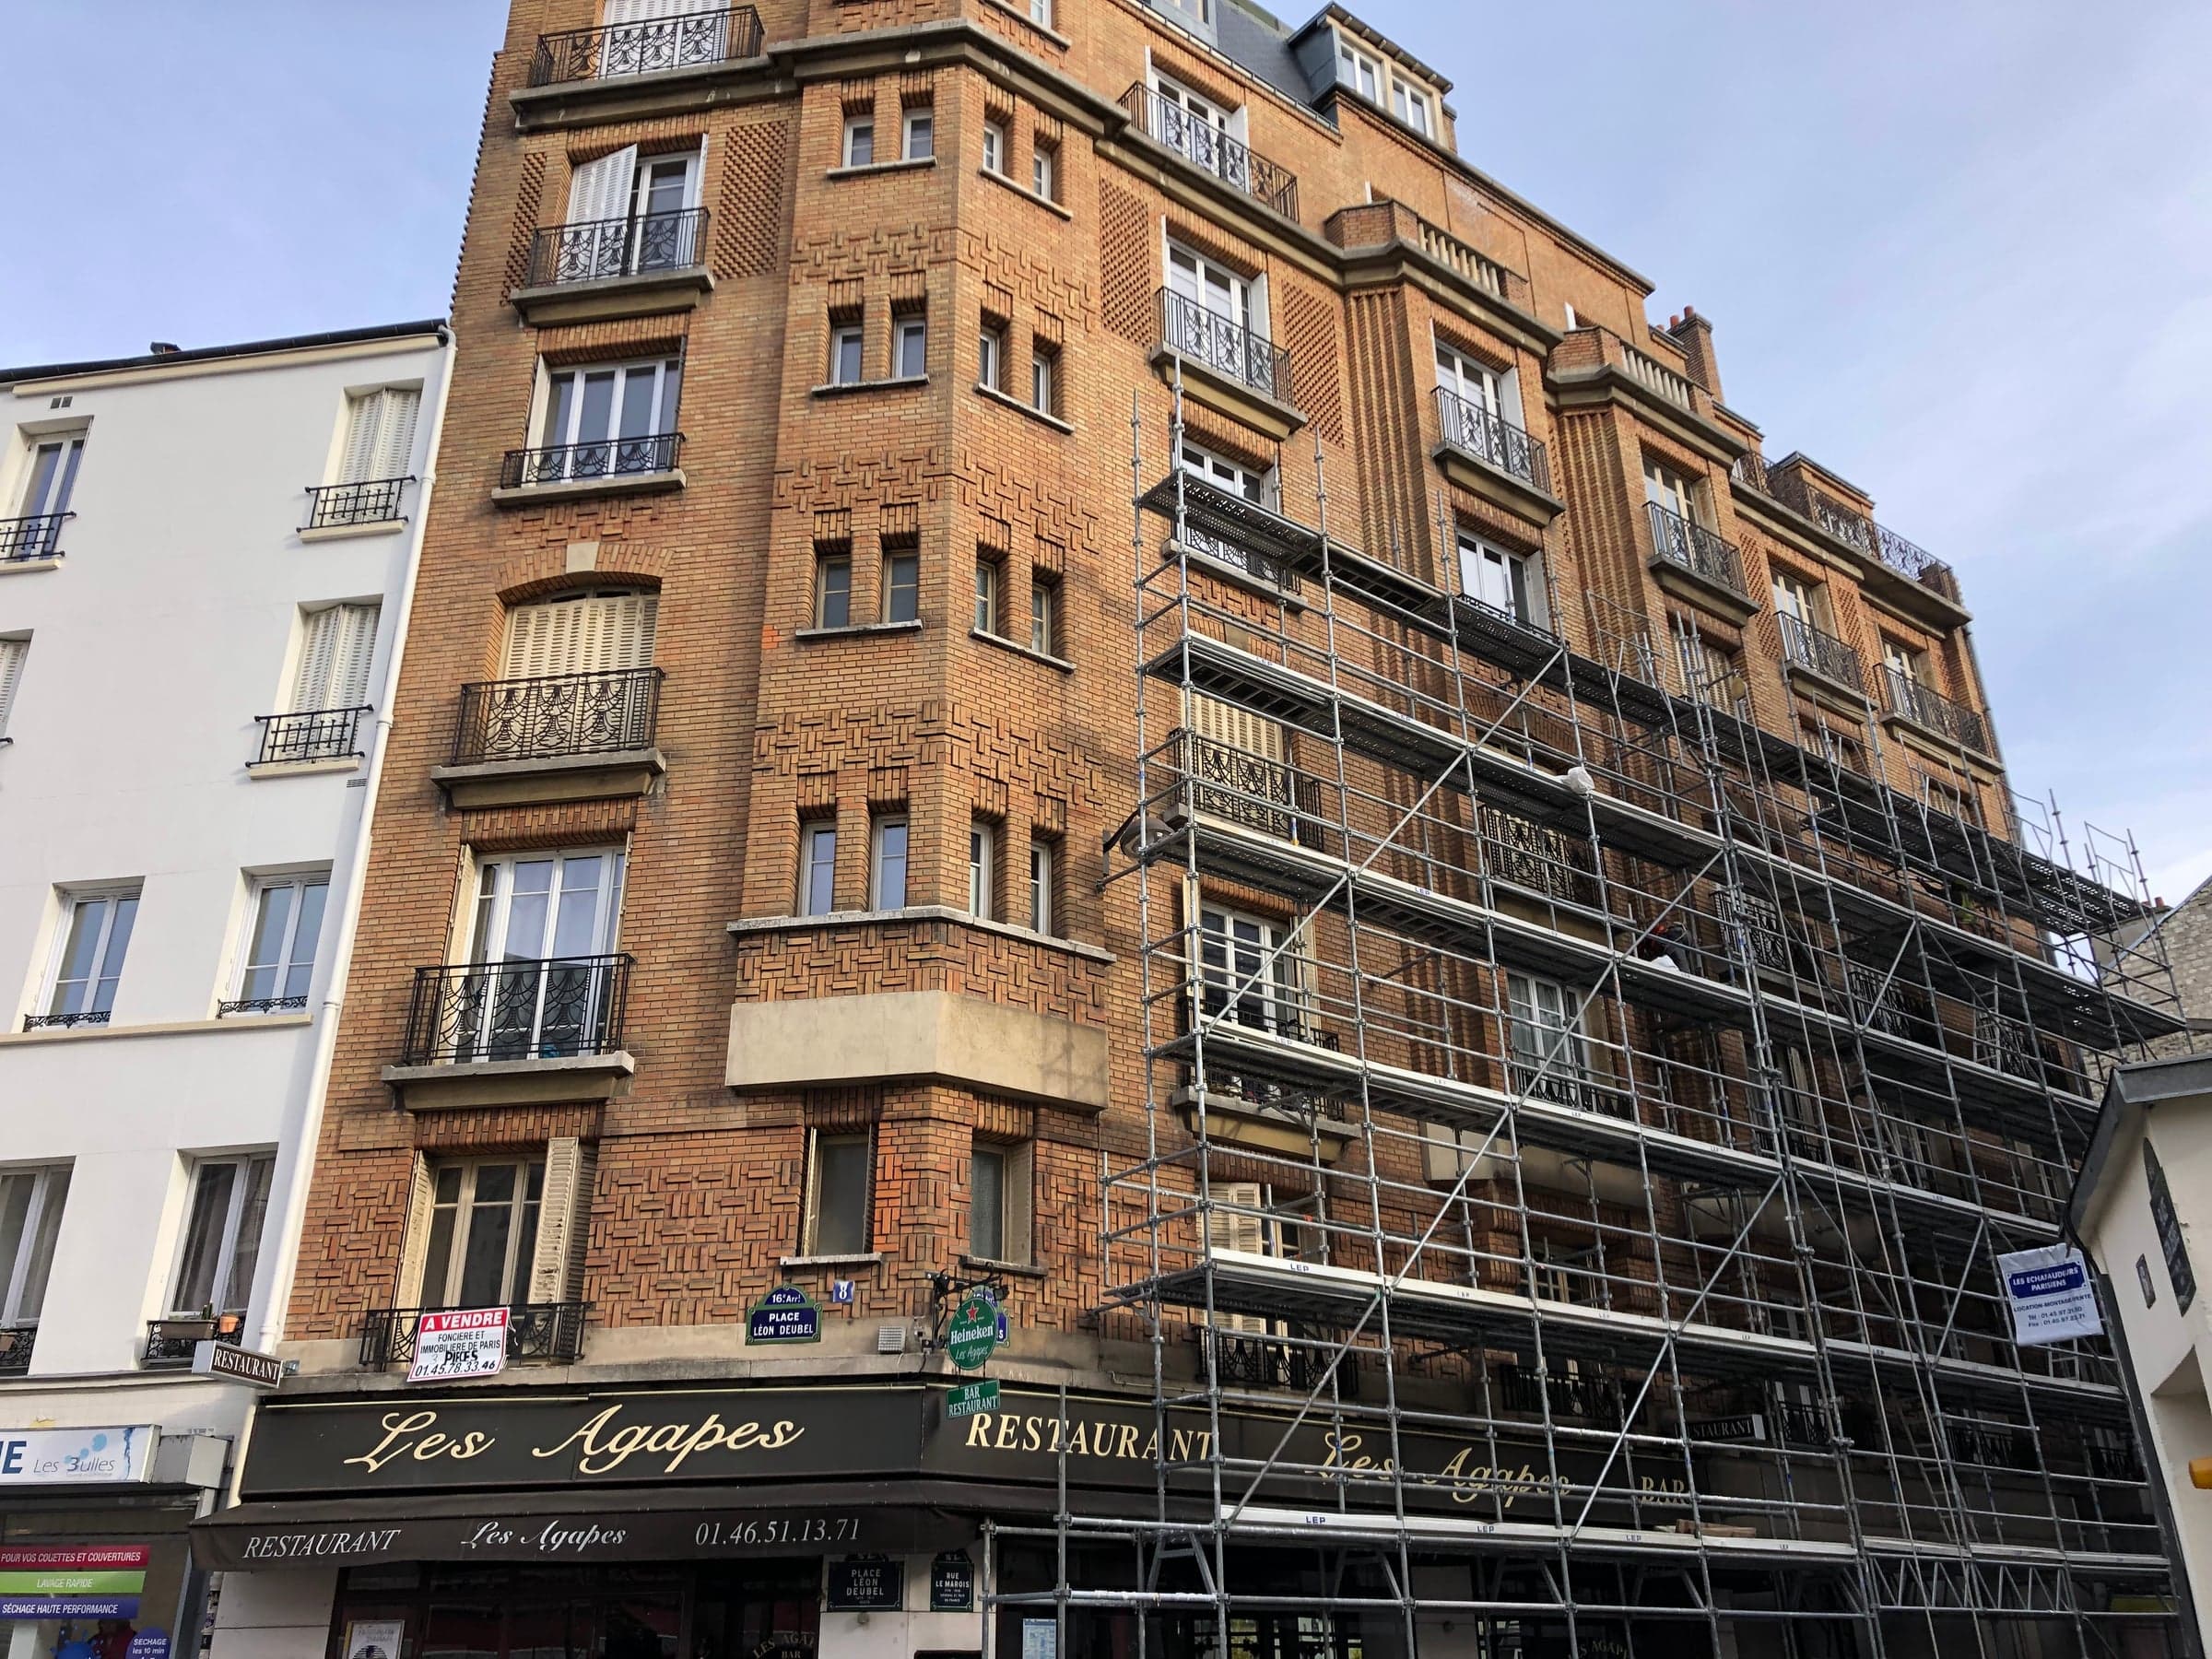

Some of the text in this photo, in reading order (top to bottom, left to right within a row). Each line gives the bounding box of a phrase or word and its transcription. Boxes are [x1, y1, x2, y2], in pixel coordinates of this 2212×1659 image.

[1290, 1263, 1310, 1272] LEP
[2013, 1277, 2025, 1286] LES
[2031, 1278, 2066, 1291] PARISIENS
[425, 1312, 503, 1330] A VENDRE
[769, 1312, 800, 1323] PLACE
[754, 1324, 813, 1336] LÉON DEUBEL
[950, 1324, 994, 1345] Heineken
[438, 1331, 485, 1343] FONCIERE ET
[420, 1339, 500, 1354] IMMOBILIERE DE PARIS
[955, 1345, 989, 1362] Les Agapes
[214, 1348, 278, 1382] RESTAURANT
[415, 1359, 496, 1377] 01.45.78.33.46
[964, 1386, 981, 1400] BAR
[948, 1395, 997, 1417] RESTAURANT
[343, 1404, 805, 1475] Les Agapes
[965, 1413, 1218, 1461] RESTAURANT
[33, 1459, 59, 1473] Les
[1306, 1516, 1326, 1524] LEP
[242, 1518, 861, 1559] RESTAURANT Les Agapes 01.46.51.13.71
[1, 1551, 141, 1562] POUR VOS COUETTES ET COUVERTURES
[65, 1578, 93, 1587] RAPIDE
[945, 1580, 970, 1588] MAROIS
[846, 1587, 884, 1595] DEUBEL
[3, 1603, 119, 1614] SÉCHAGE HAUTE PERFORMANCE
